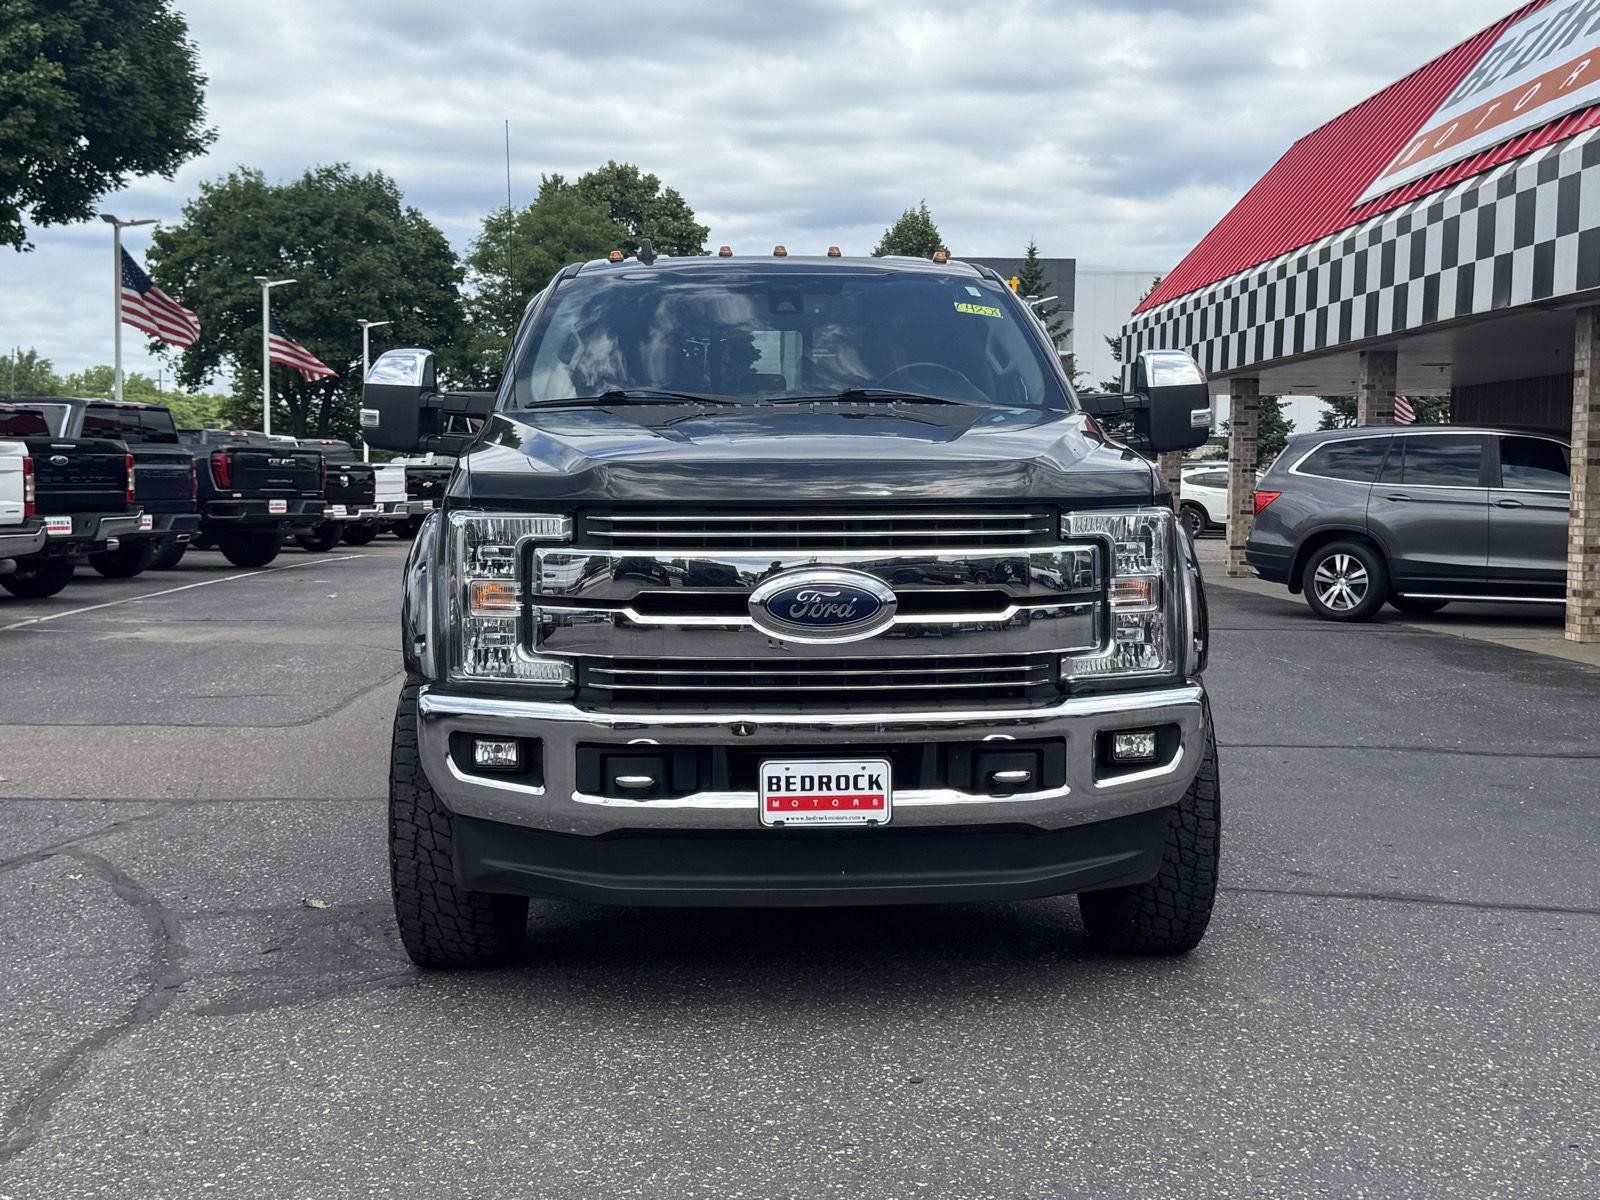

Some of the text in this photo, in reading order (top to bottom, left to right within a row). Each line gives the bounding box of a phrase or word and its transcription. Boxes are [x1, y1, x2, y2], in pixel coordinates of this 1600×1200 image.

[788, 589, 858, 619] Ford
[767, 774, 883, 792] BEDROCK
[772, 798, 879, 808] MOTORS
